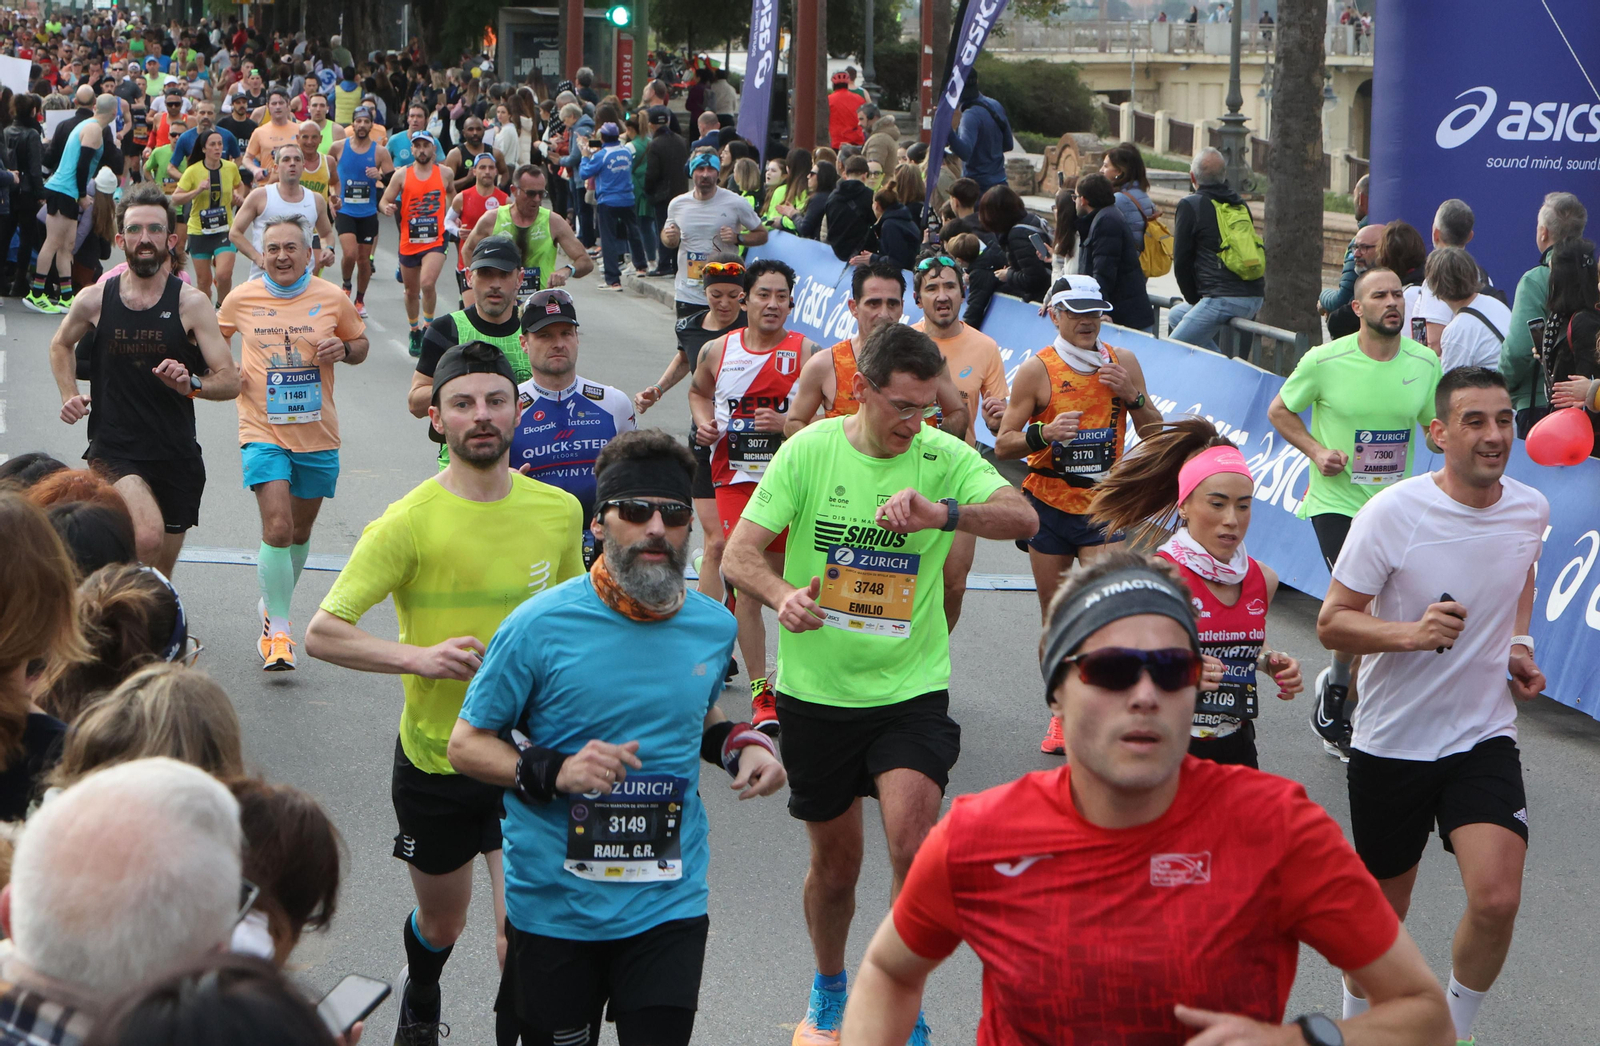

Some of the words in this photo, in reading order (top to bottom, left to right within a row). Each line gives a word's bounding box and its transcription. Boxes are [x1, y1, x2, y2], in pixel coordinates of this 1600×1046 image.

[622, 54, 631, 86] PASEO
[1486, 156, 1529, 168] sound
[1531, 156, 1563, 171] mind,
[1566, 158, 1596, 170] sound
[114, 329, 128, 339] EL
[133, 330, 163, 340] JEFE
[288, 325, 313, 333] Sevilla
[286, 373, 316, 382] ZURICH
[284, 391, 307, 400] 11481
[727, 397, 789, 415] PERU
[523, 421, 557, 435] Ekopak
[568, 418, 601, 426] latexco
[1075, 431, 1107, 440] ZURICH
[1376, 433, 1406, 441] ZURICH
[748, 439, 769, 448] 3077
[743, 453, 774, 461] RICHARD
[1072, 450, 1094, 460] 3170
[1374, 451, 1394, 459] 7300
[1065, 464, 1102, 472] RAMONCIN
[844, 526, 908, 548] SIRIUS
[859, 554, 909, 569] ZURICH
[854, 580, 884, 596] 3748
[848, 602, 883, 616] EMILIO
[1198, 630, 1246, 641] atletismo
[1249, 628, 1264, 640] club
[1203, 691, 1235, 706] 3109
[611, 781, 673, 795] ZURICH
[609, 816, 647, 833] 3149
[593, 844, 630, 857] RAUL.
[633, 844, 655, 857] G.R.
